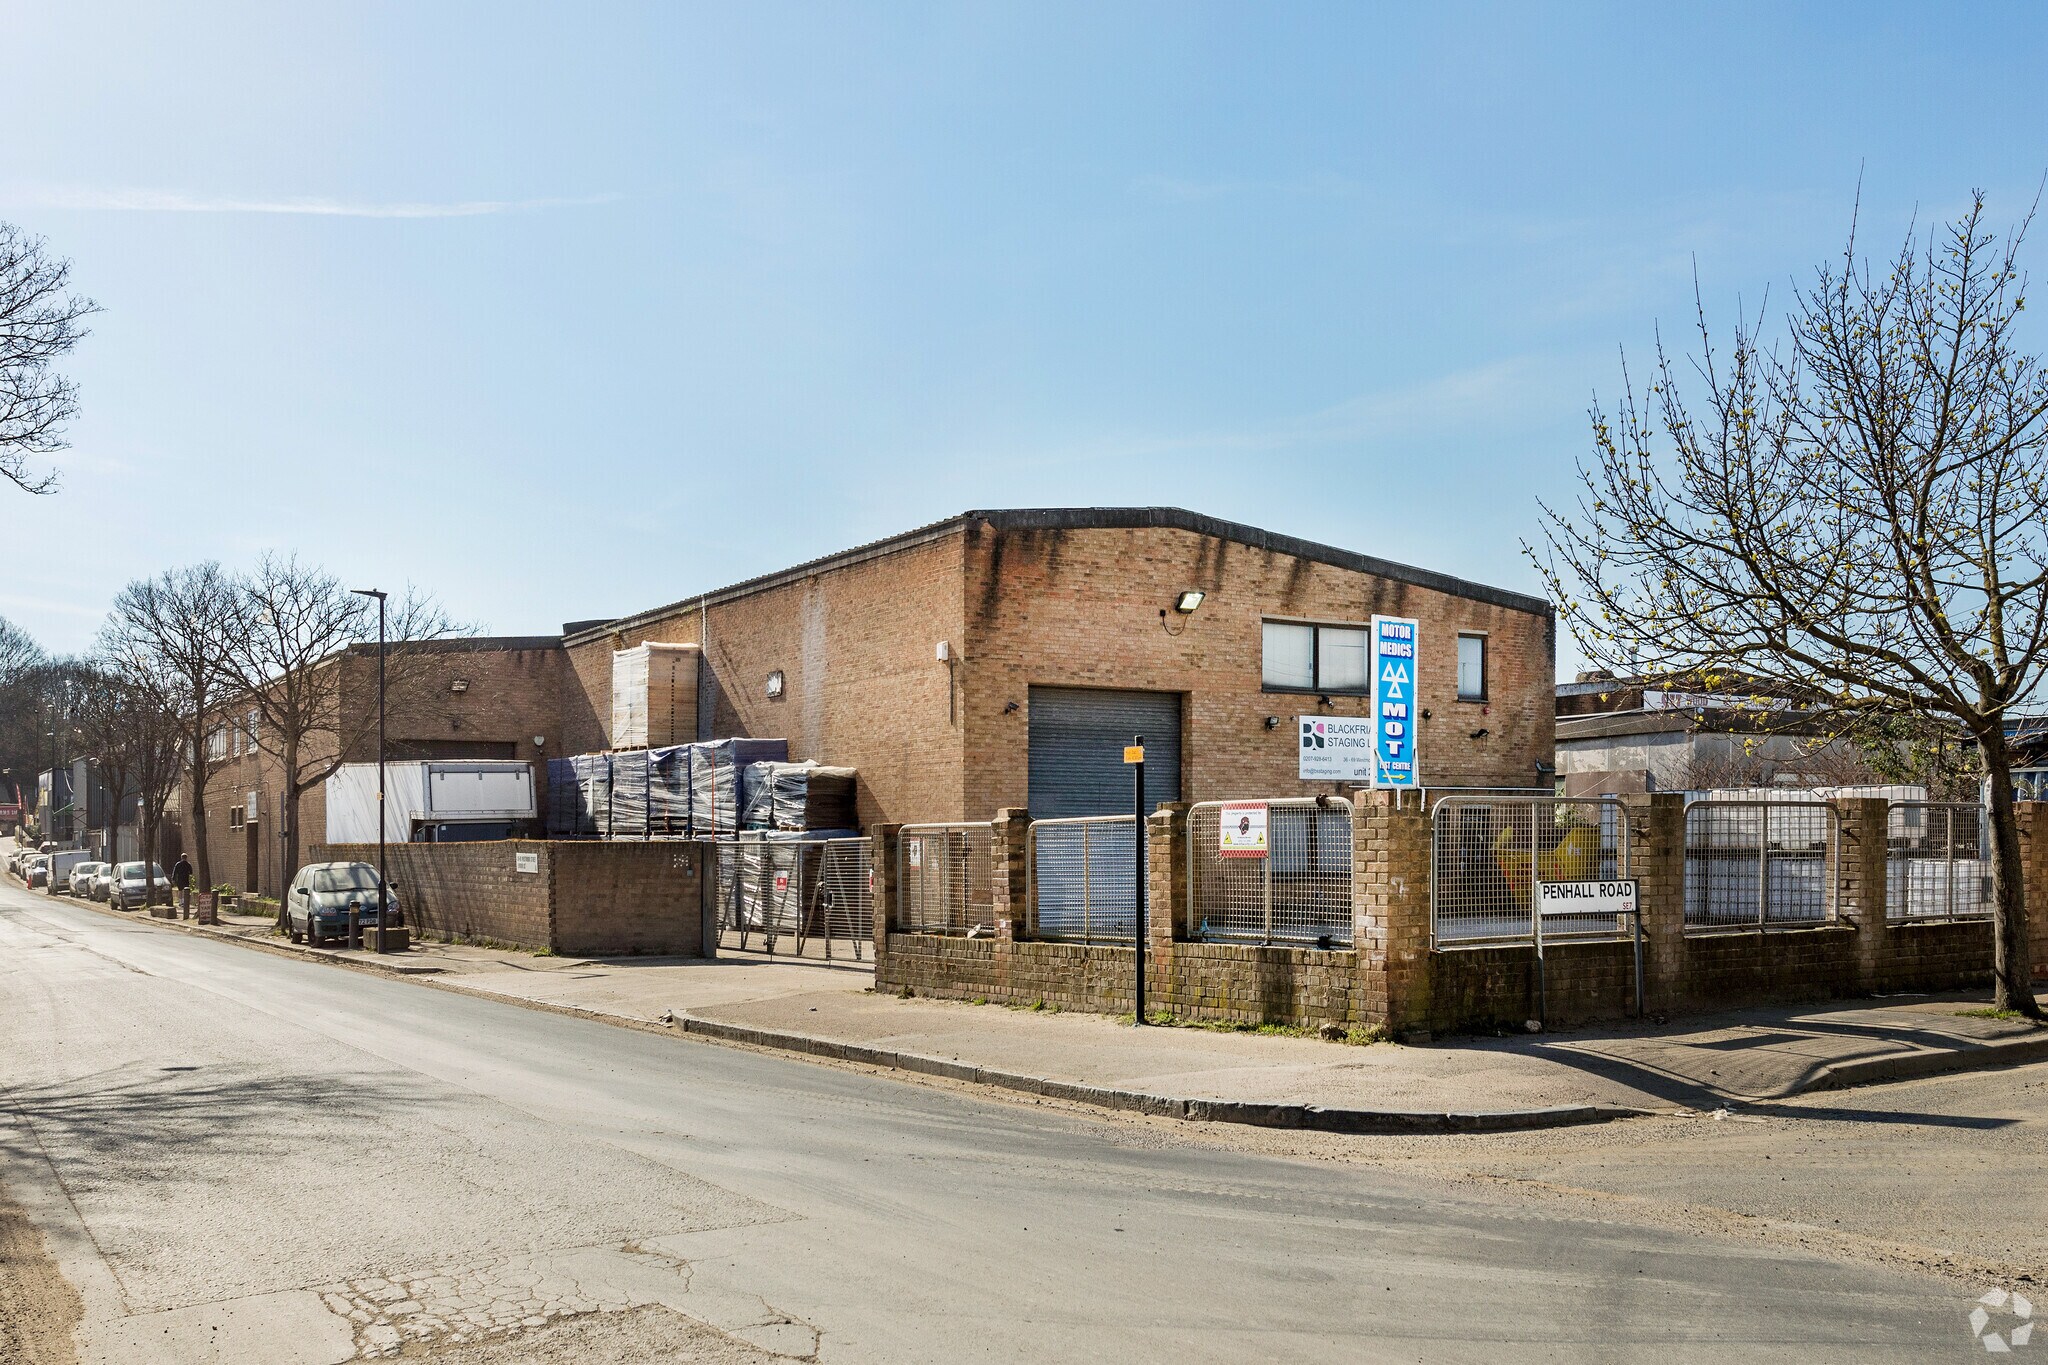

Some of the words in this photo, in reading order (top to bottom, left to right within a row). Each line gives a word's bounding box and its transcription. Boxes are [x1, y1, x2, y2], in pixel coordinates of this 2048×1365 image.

[1381, 623, 1411, 639] MOTOR
[1380, 641, 1412, 657] MEDICS
[1382, 702, 1407, 756] MOT
[1327, 737, 1366, 748] STAGING
[1353, 767, 1366, 776] unit
[1392, 762, 1411, 771] CENTRE
[1543, 884, 1595, 899] PENHALL
[1600, 883, 1632, 897] ROAD
[1622, 902, 1632, 910] SE7
